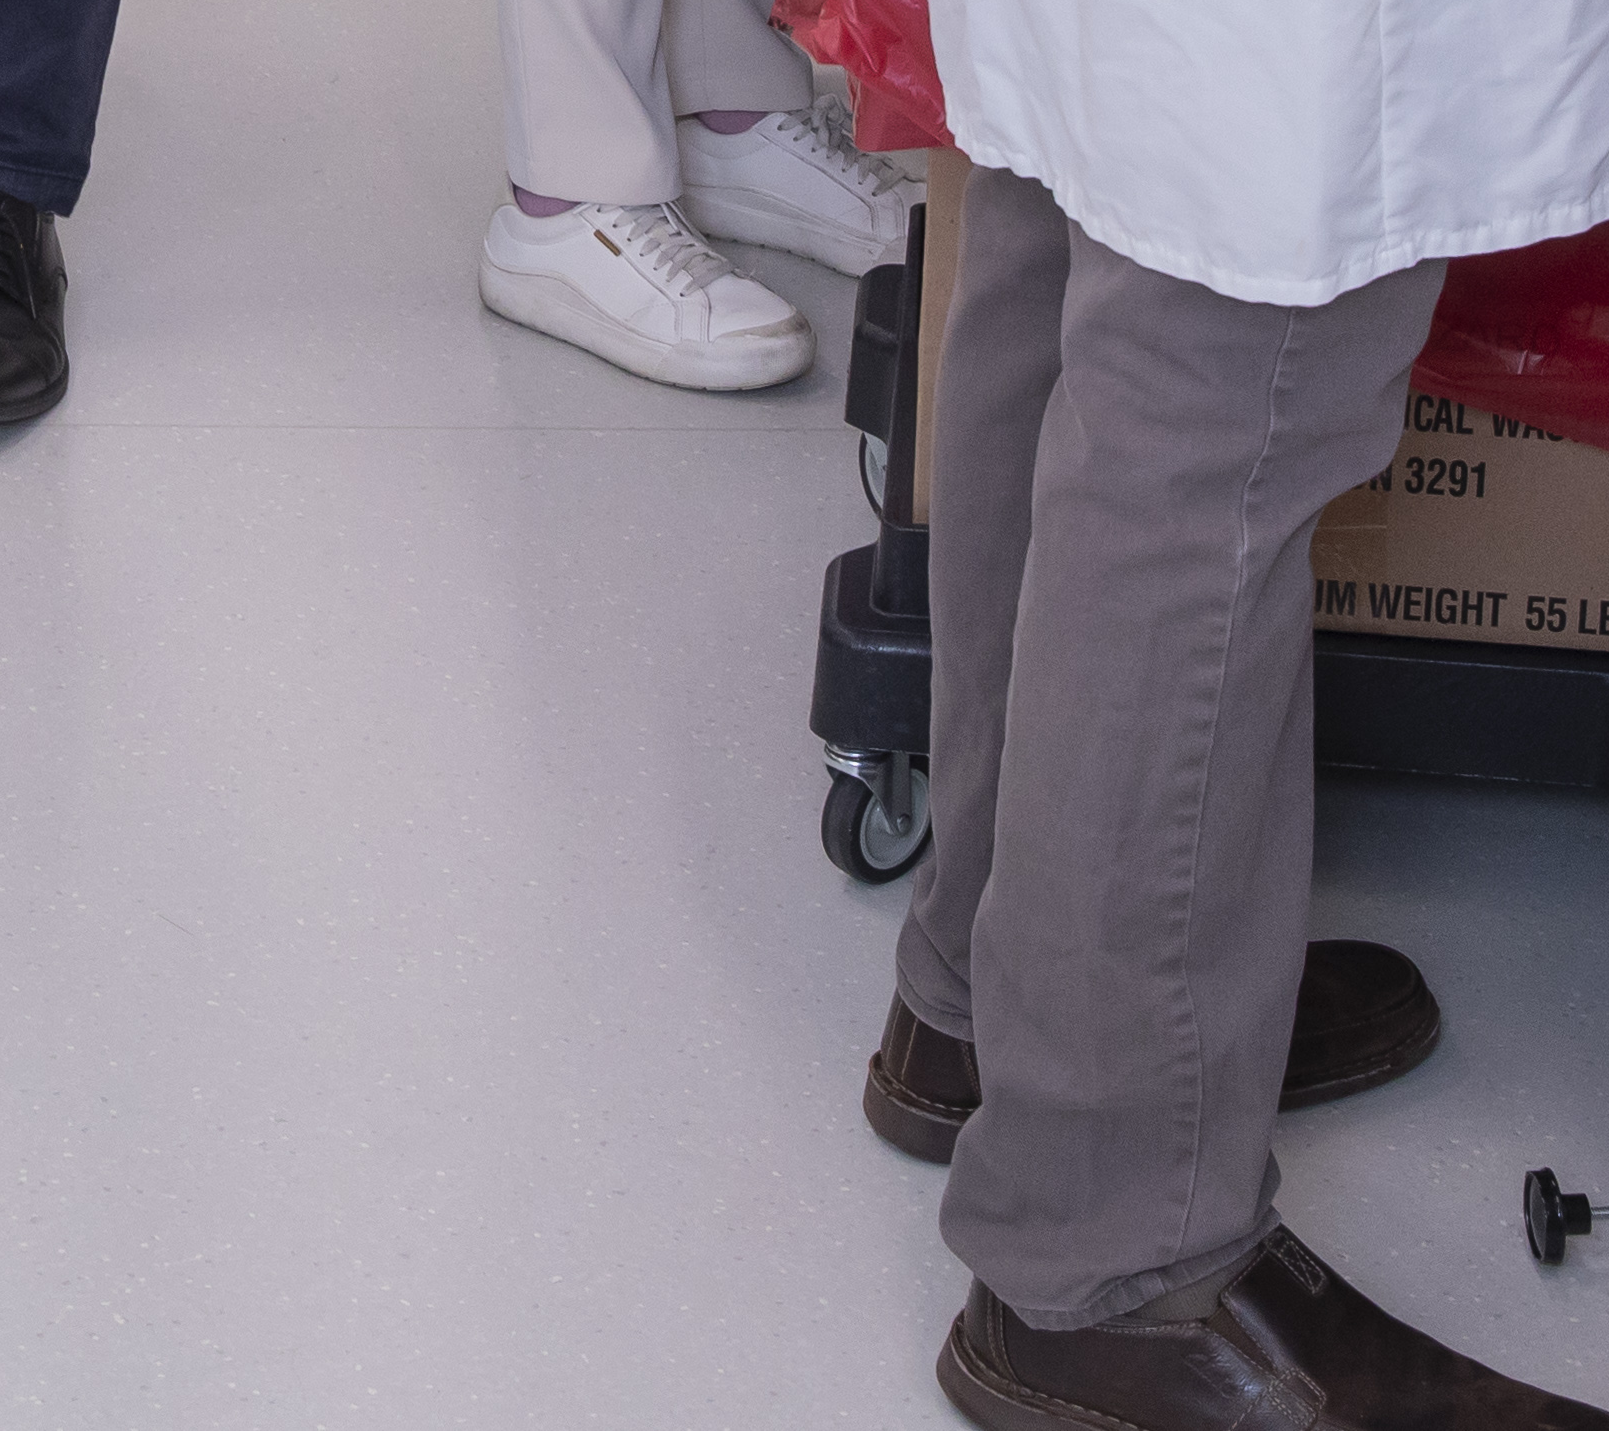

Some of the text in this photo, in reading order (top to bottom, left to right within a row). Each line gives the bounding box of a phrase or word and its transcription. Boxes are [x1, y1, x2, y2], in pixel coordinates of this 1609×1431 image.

[1405, 456, 1487, 498] 3291
[1368, 582, 1508, 628] WEIGHT
[1525, 595, 1568, 633] 55
